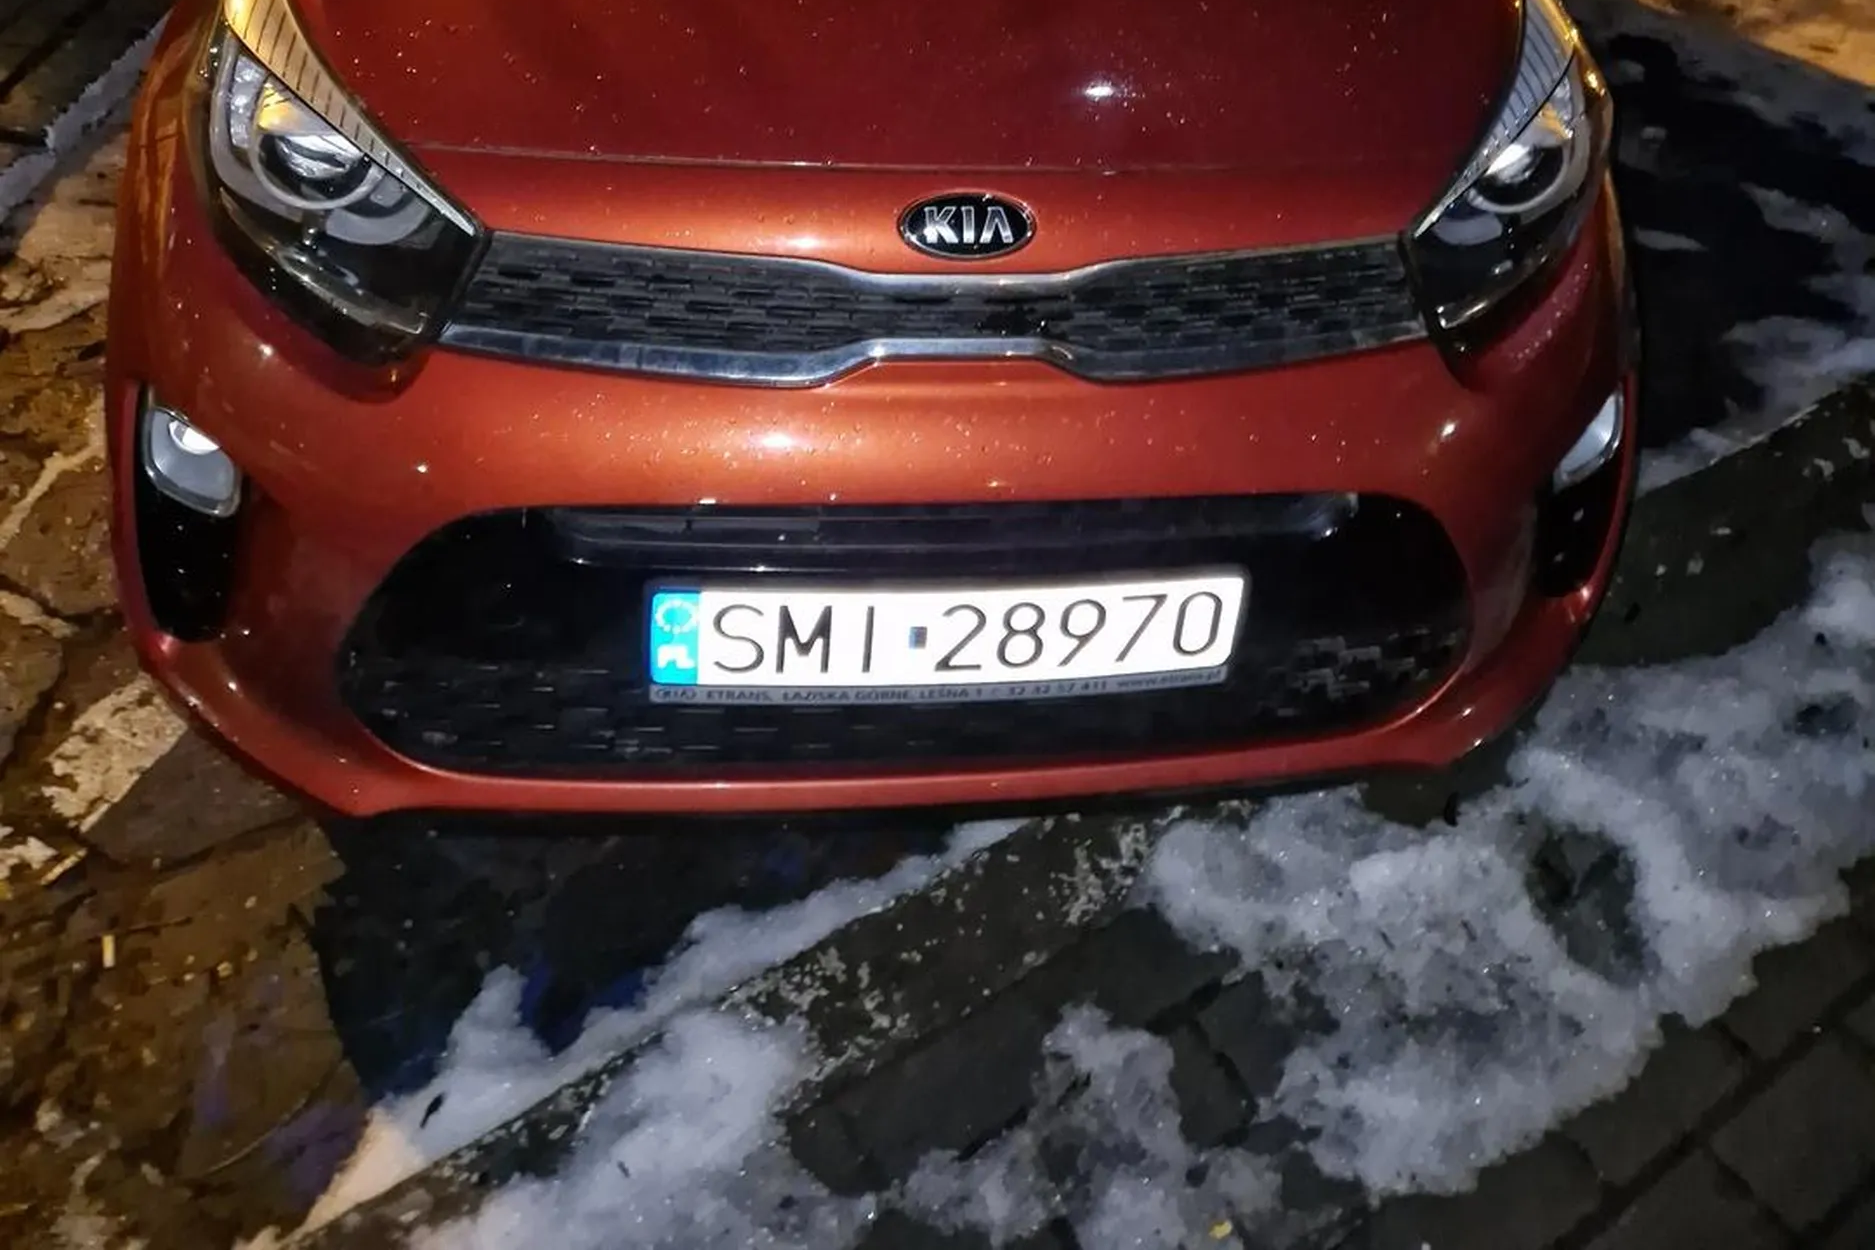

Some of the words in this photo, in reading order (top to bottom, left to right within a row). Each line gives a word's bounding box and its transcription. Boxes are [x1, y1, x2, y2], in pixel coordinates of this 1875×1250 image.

[924, 206, 1014, 244] KIA
[712, 603, 876, 674] SMI
[934, 591, 1223, 672] 28970
[657, 645, 697, 669] PL
